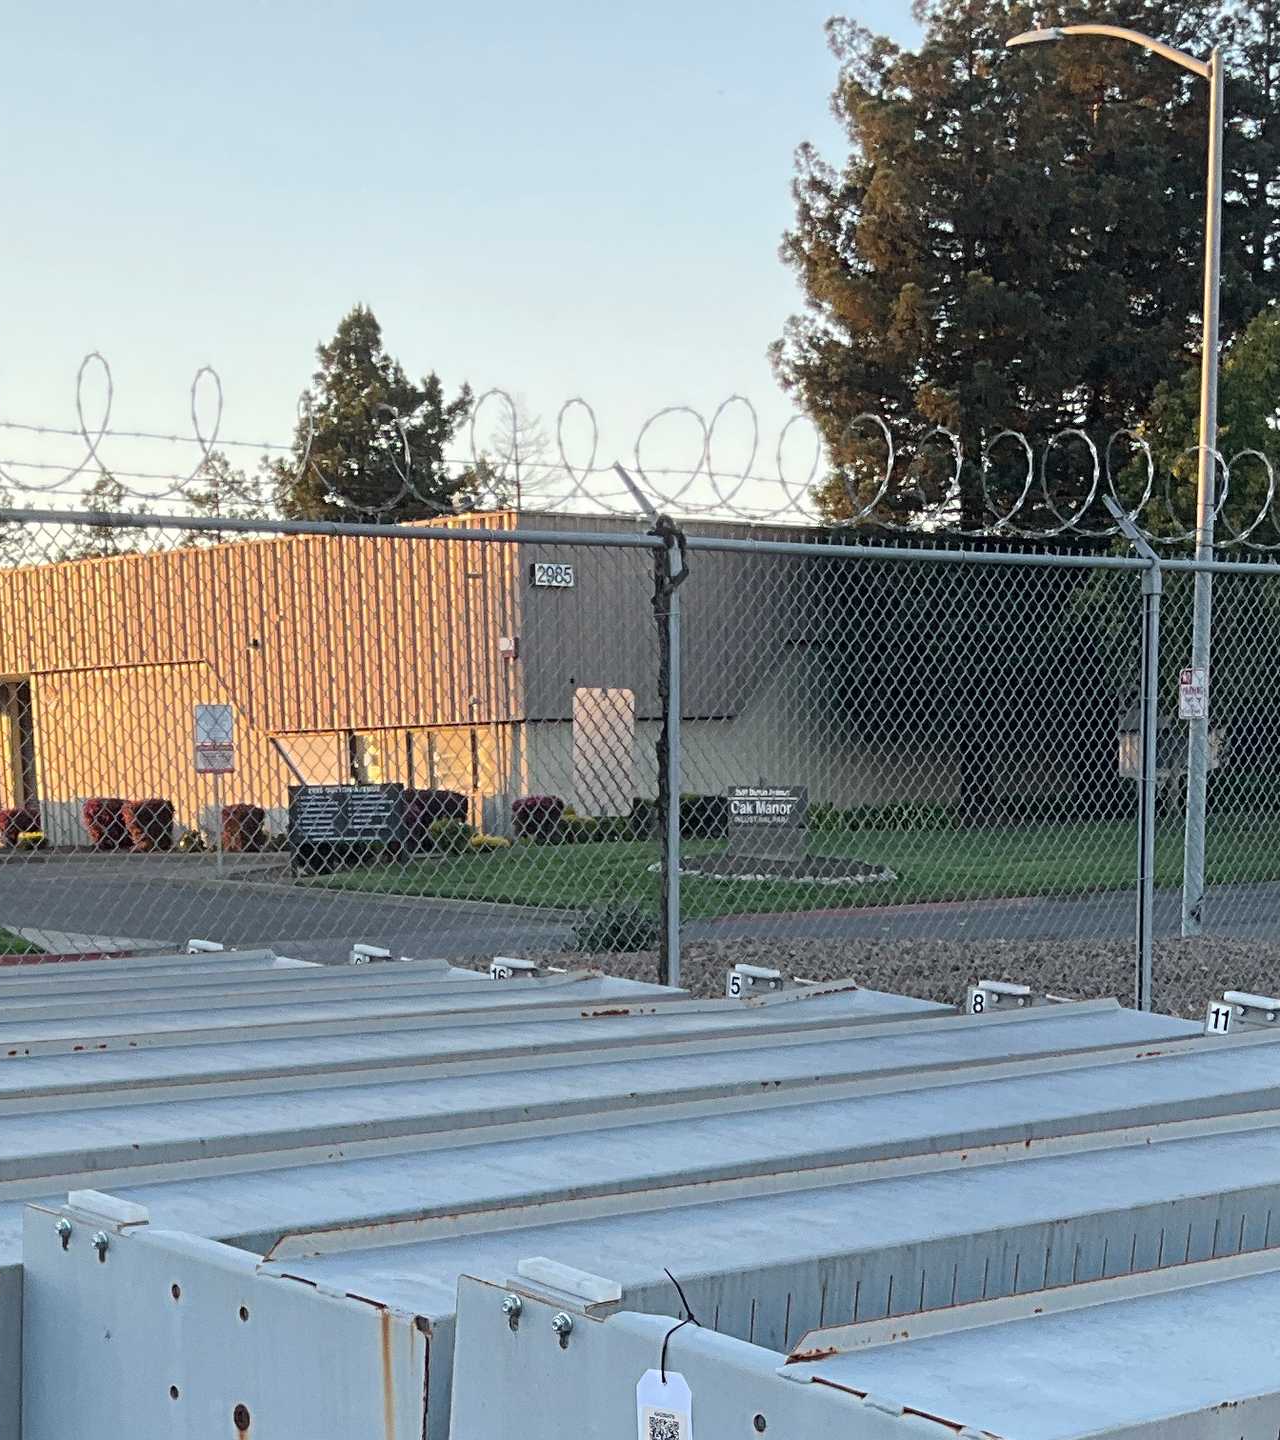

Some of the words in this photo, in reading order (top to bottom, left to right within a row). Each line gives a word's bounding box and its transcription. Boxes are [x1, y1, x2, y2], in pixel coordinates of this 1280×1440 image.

[537, 565, 573, 584] 2985
[756, 801, 792, 815] Manor
[731, 976, 741, 995] 5
[973, 994, 984, 1014] 8
[1211, 1008, 1230, 1031] 11
